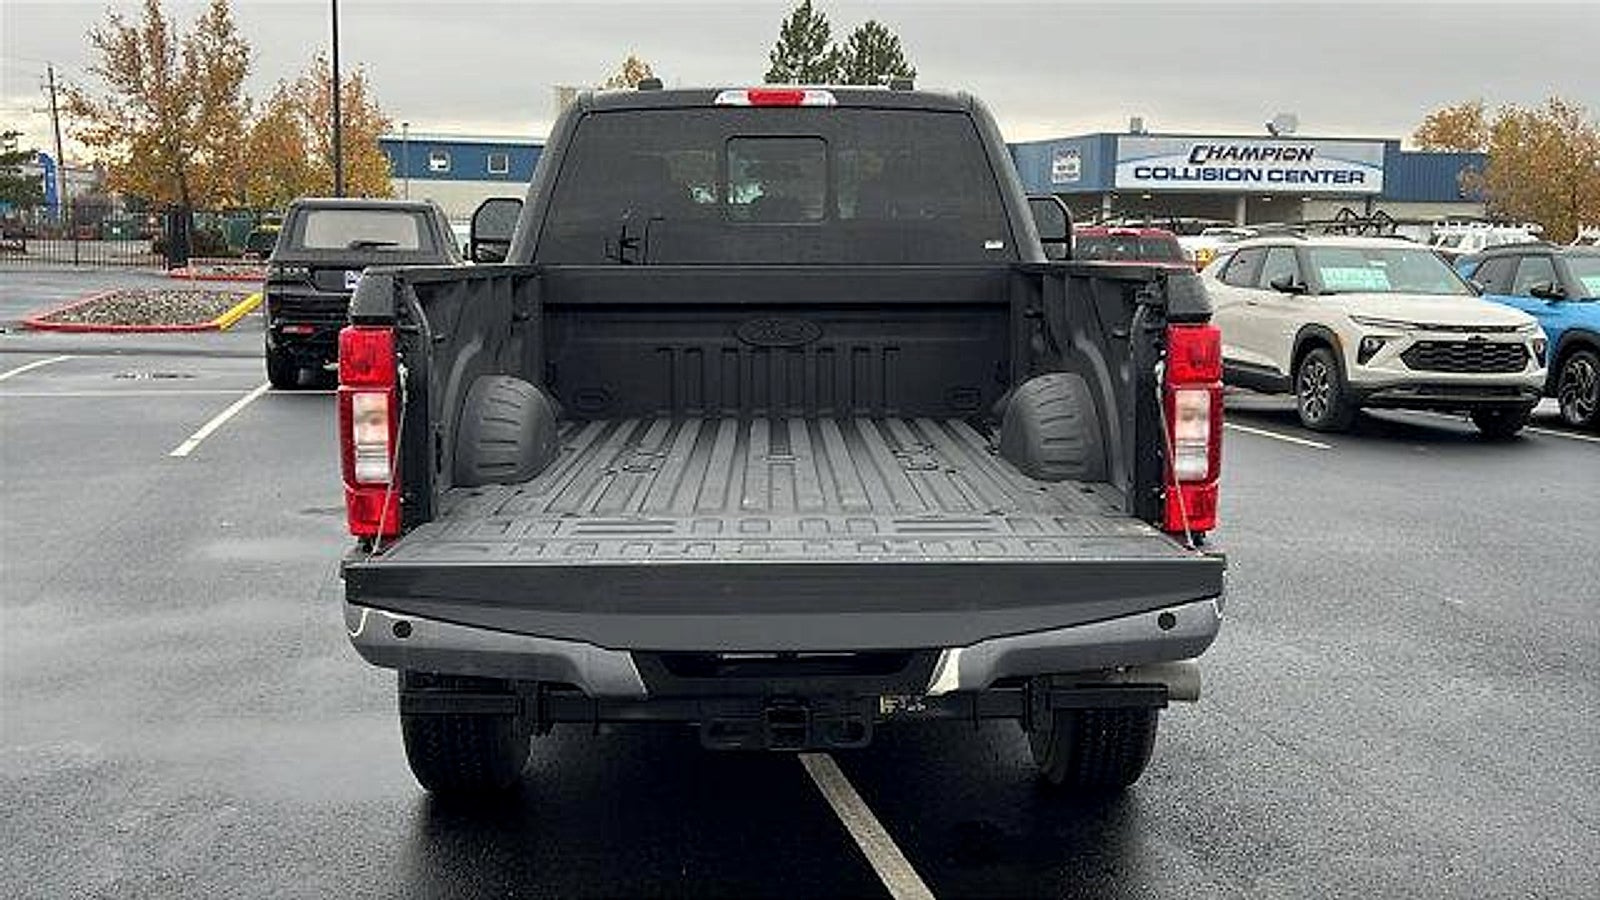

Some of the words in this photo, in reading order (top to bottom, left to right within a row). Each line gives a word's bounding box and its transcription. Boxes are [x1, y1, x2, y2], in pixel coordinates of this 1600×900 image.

[1189, 145, 1315, 164] CHAMPION
[1135, 166, 1262, 182] COLLISION
[1267, 168, 1366, 184] CENTER
